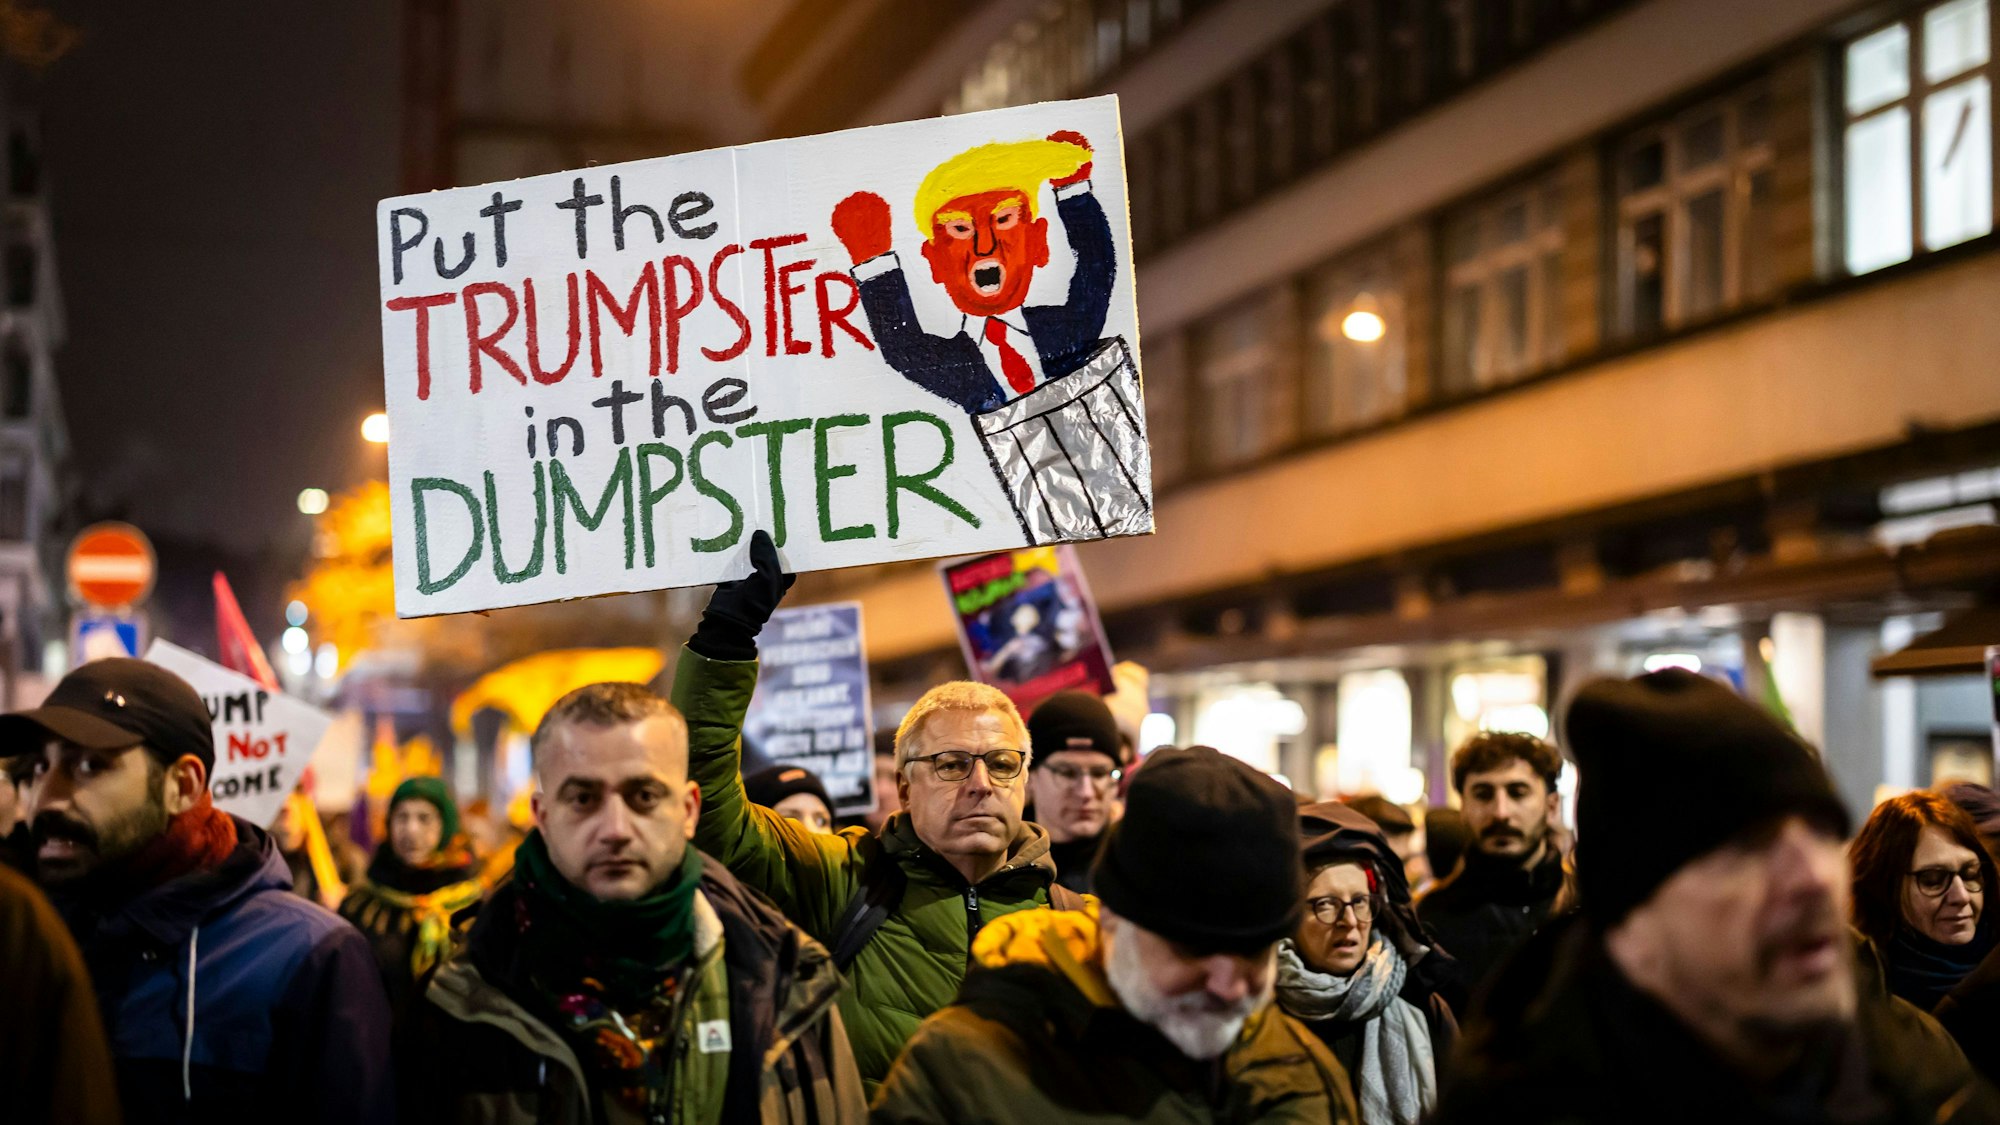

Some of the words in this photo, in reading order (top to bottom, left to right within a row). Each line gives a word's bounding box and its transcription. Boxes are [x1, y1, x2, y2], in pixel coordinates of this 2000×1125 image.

[390, 191, 524, 285] Put
[554, 175, 719, 259] the
[386, 232, 875, 400] TRUMPSTER
[524, 405, 585, 459] in
[591, 377, 759, 445] the
[411, 410, 982, 596] DUMPSTER
[202, 690, 268, 721] UMP
[212, 766, 281, 800] COME
